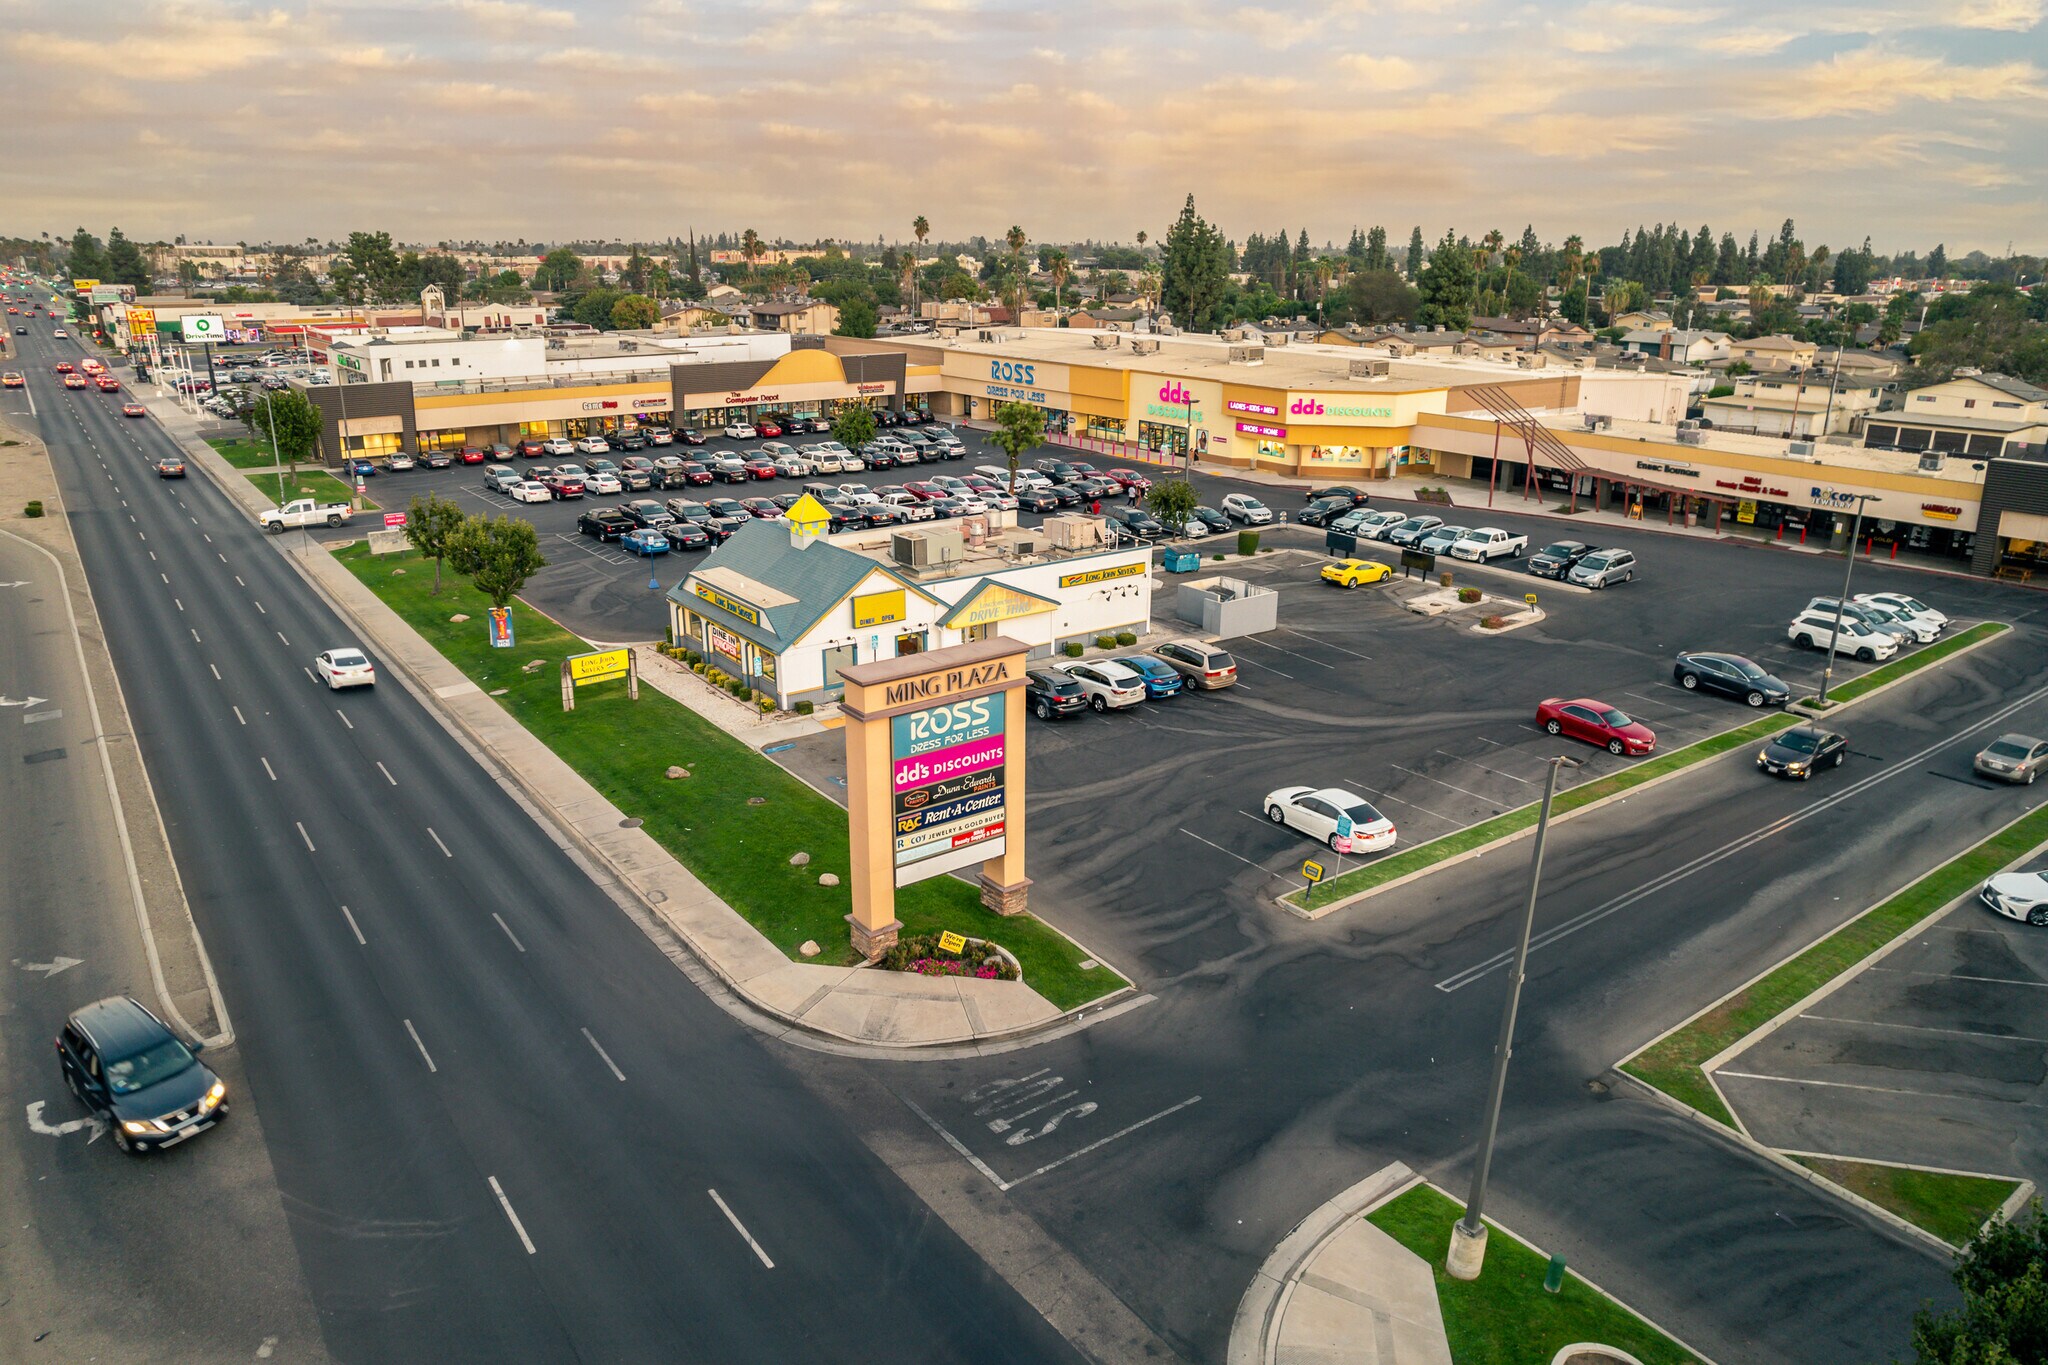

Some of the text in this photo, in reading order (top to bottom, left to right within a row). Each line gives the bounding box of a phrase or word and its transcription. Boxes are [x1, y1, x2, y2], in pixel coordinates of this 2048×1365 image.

[991, 360, 1035, 385] ROSS
[986, 385, 1046, 402] DRESS FOR LESS
[583, 401, 618, 410] GameStop
[1147, 404, 1203, 423] DISCOUNTS
[1230, 402, 1246, 410] LADIES
[1326, 406, 1392, 417] DISCOUNTS
[1242, 424, 1278, 436] SHOES HOME
[1812, 498, 1852, 508] JEWELRY
[1085, 573, 1100, 581] LONG
[1102, 571, 1116, 579] JOHN
[970, 601, 1032, 622] DRIVE THRU
[712, 627, 736, 645] DINE IN
[886, 662, 1008, 705] MING PLAZA
[910, 696, 990, 740] ROSS
[910, 726, 990, 754] DRESS FOR LESS
[895, 747, 1003, 785] dd's DISCOUNTS
[973, 781, 997, 793] PAINTS
[898, 815, 922, 832] RAC
[928, 827, 956, 840] JEWELRY
[965, 819, 983, 829] GOLD
[944, 938, 961, 947] Open
[946, 933, 963, 942] We're
[961, 1067, 1098, 1146] STOP
